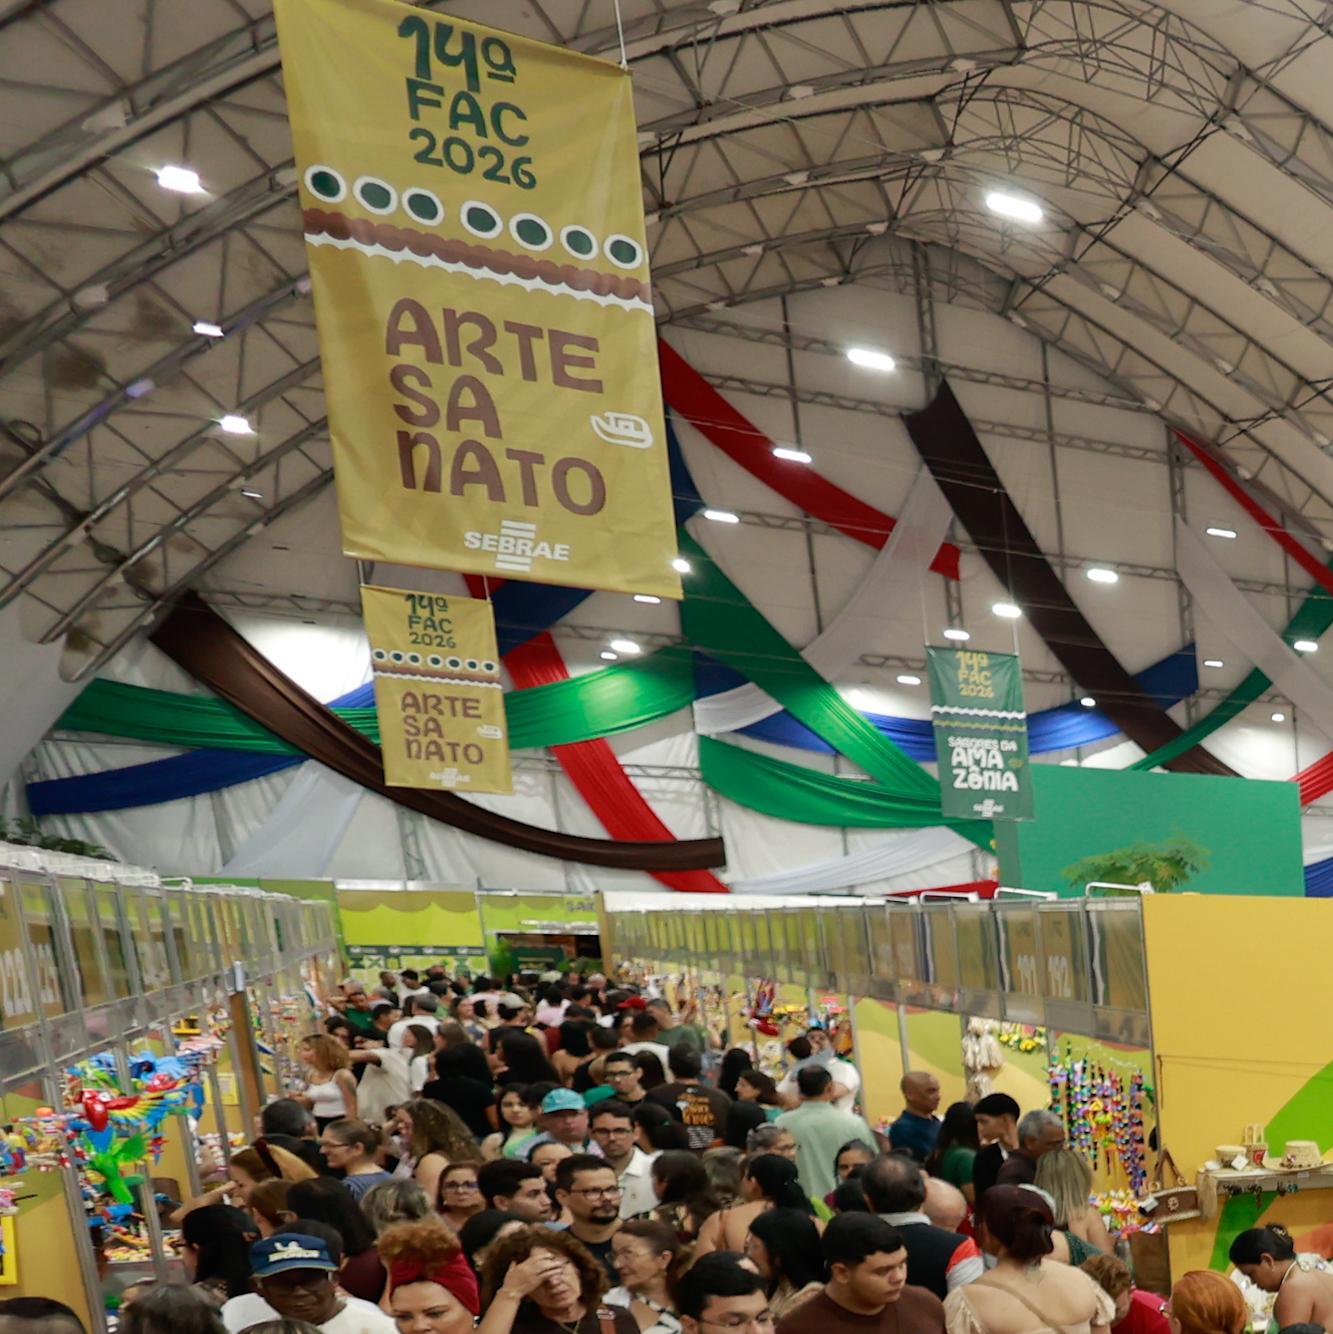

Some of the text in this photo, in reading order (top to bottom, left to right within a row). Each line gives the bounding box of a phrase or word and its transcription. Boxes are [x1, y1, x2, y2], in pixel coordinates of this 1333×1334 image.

[406, 77, 530, 146] FAC
[409, 129, 537, 190] 2026
[386, 297, 603, 393] ARTE
[389, 363, 502, 439] SA
[396, 430, 606, 516] NATO
[464, 530, 570, 562] SEBRAE
[408, 615, 453, 633] FAC
[409, 632, 456, 648] 2026
[958, 670, 992, 685] FAC
[401, 691, 482, 719] ARTE
[403, 714, 444, 738] SA
[405, 738, 484, 765] NATO
[951, 747, 1004, 769] AMA
